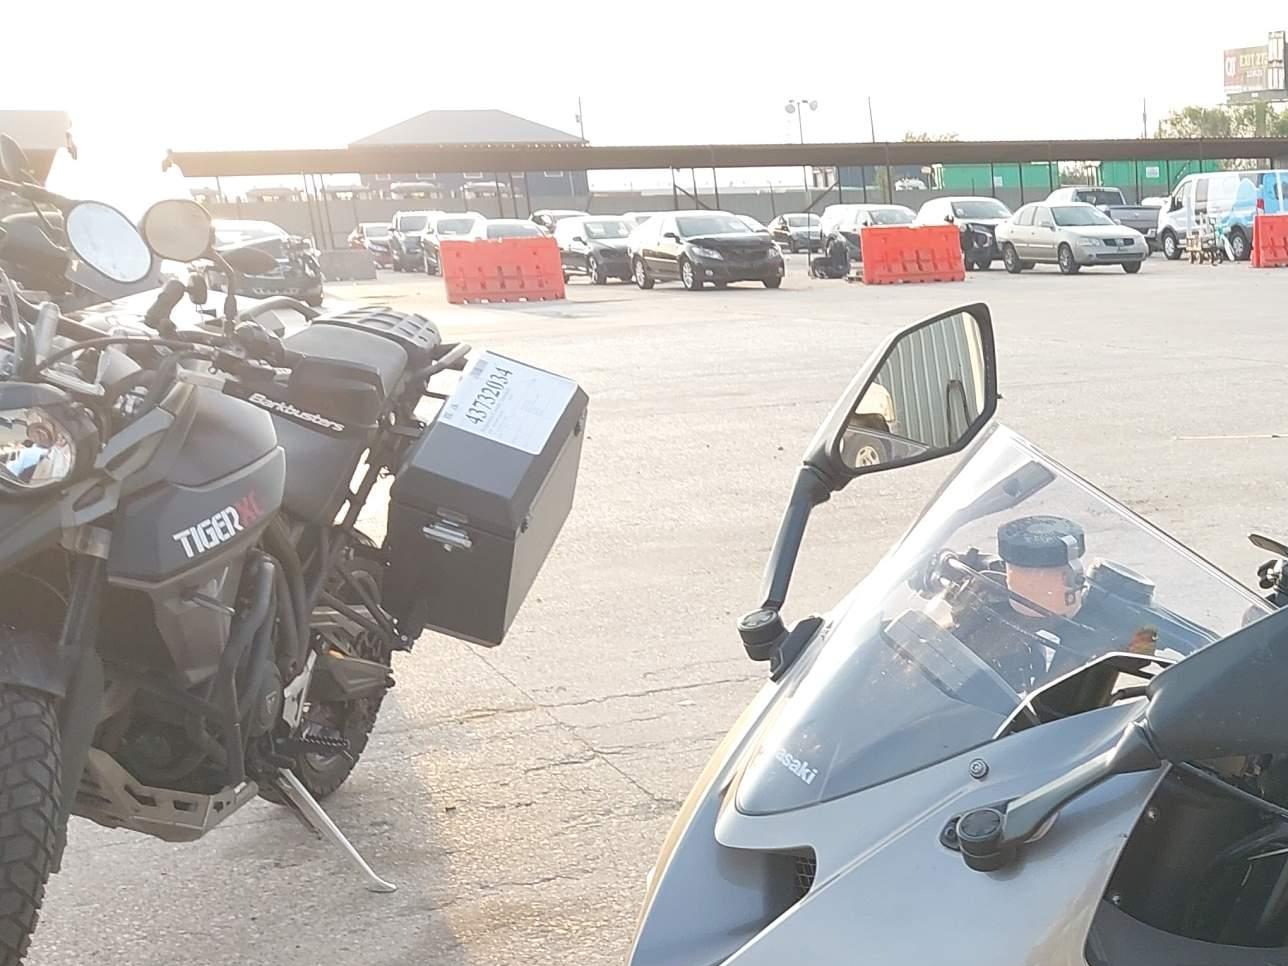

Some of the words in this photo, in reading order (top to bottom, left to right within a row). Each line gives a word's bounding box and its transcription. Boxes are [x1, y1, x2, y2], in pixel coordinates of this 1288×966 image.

[248, 393, 345, 432] Barkbusters
[465, 367, 513, 425] 43732034
[775, 748, 819, 785] asaki
